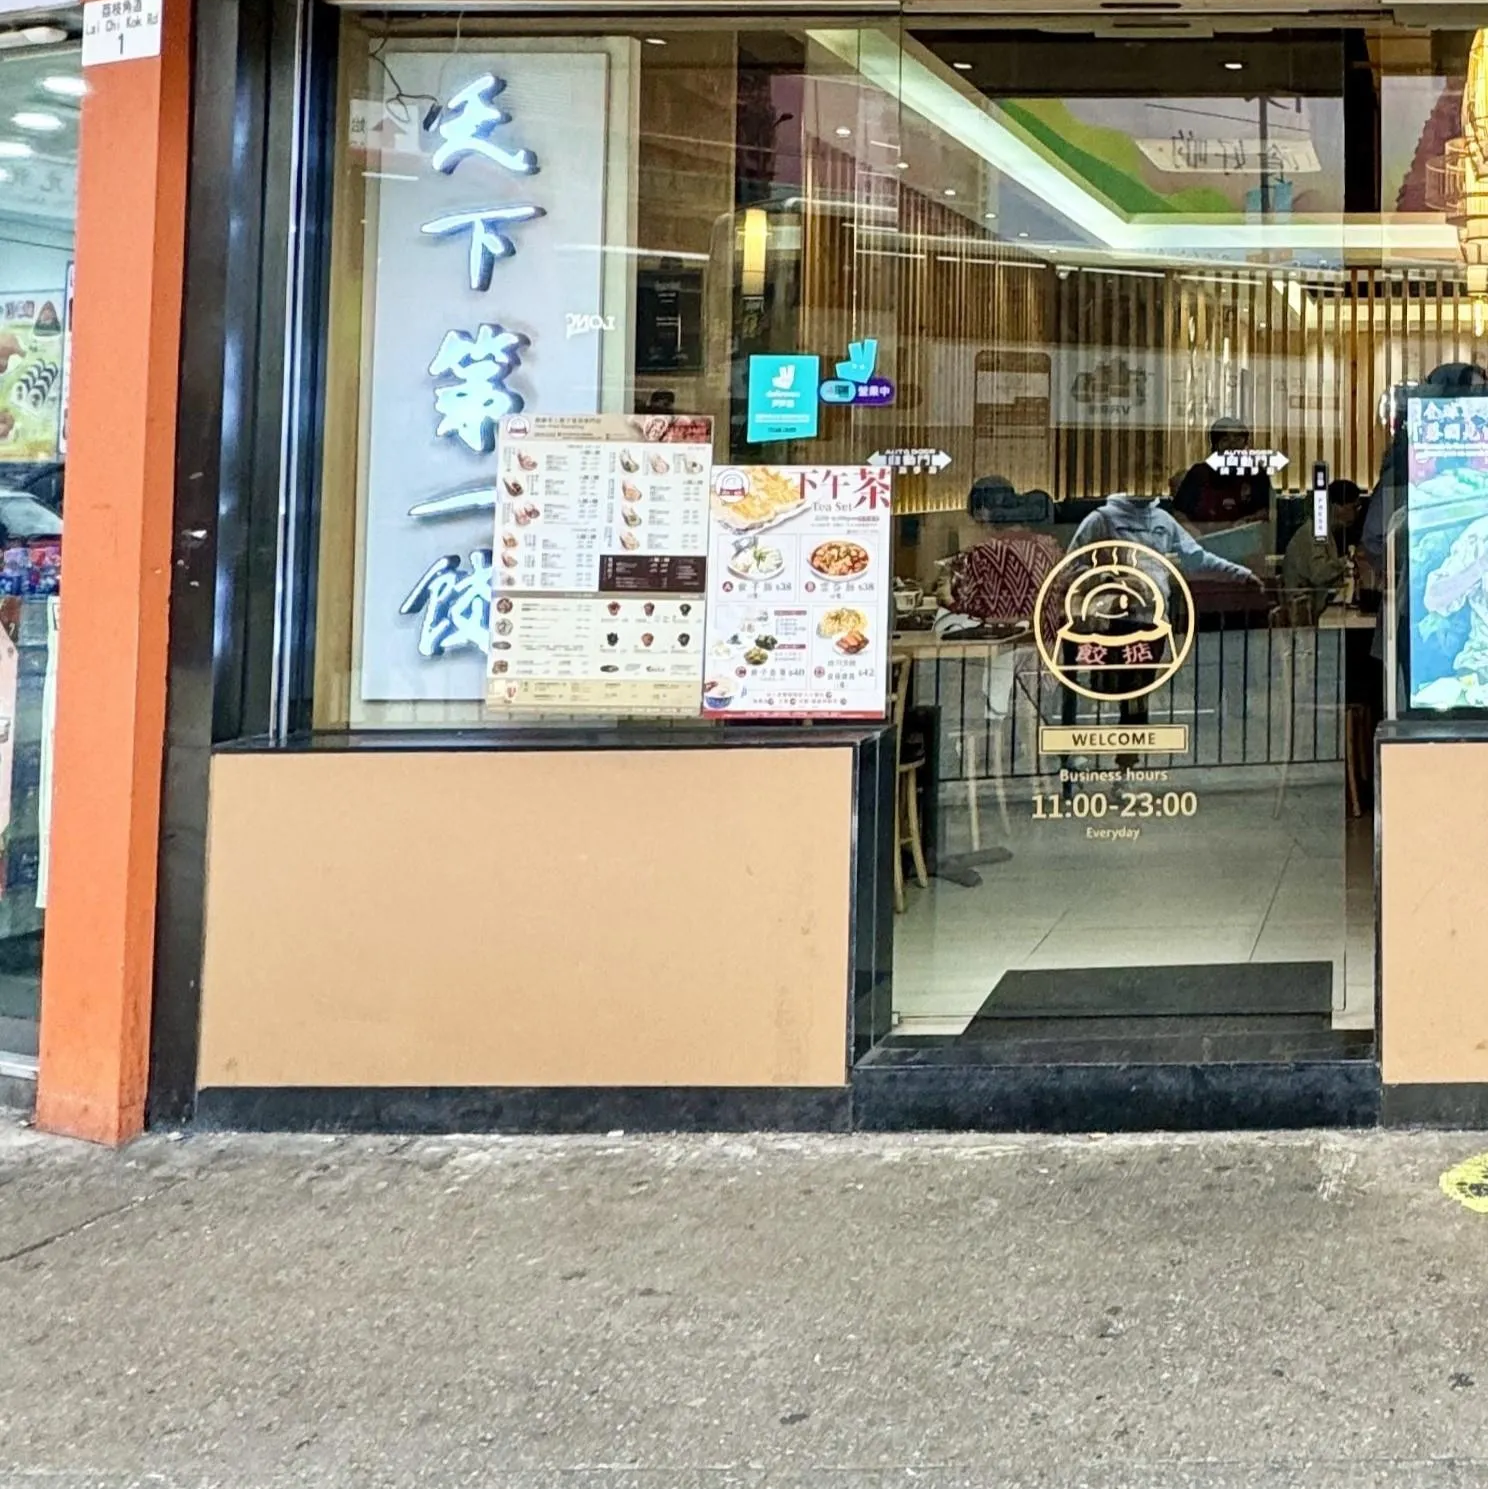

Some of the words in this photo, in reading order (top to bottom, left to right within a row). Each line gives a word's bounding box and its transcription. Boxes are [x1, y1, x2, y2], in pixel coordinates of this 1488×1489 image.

[86, 20, 100, 35] Lai
[105, 19, 120, 32] Chi
[126, 16, 142, 28] Kok
[147, 13, 159, 25] Rd
[118, 33, 124, 55] 1
[790, 468, 891, 510] 下午茶
[812, 501, 832, 512] Tea
[834, 501, 853, 512] Set
[1076, 642, 1153, 665] 餃掂
[1072, 733, 1156, 746] WELCOME
[1059, 768, 1122, 782] Business
[1126, 768, 1168, 782] hours
[1031, 792, 1198, 819] 11:00-23:00
[1086, 827, 1141, 840] Everyday
